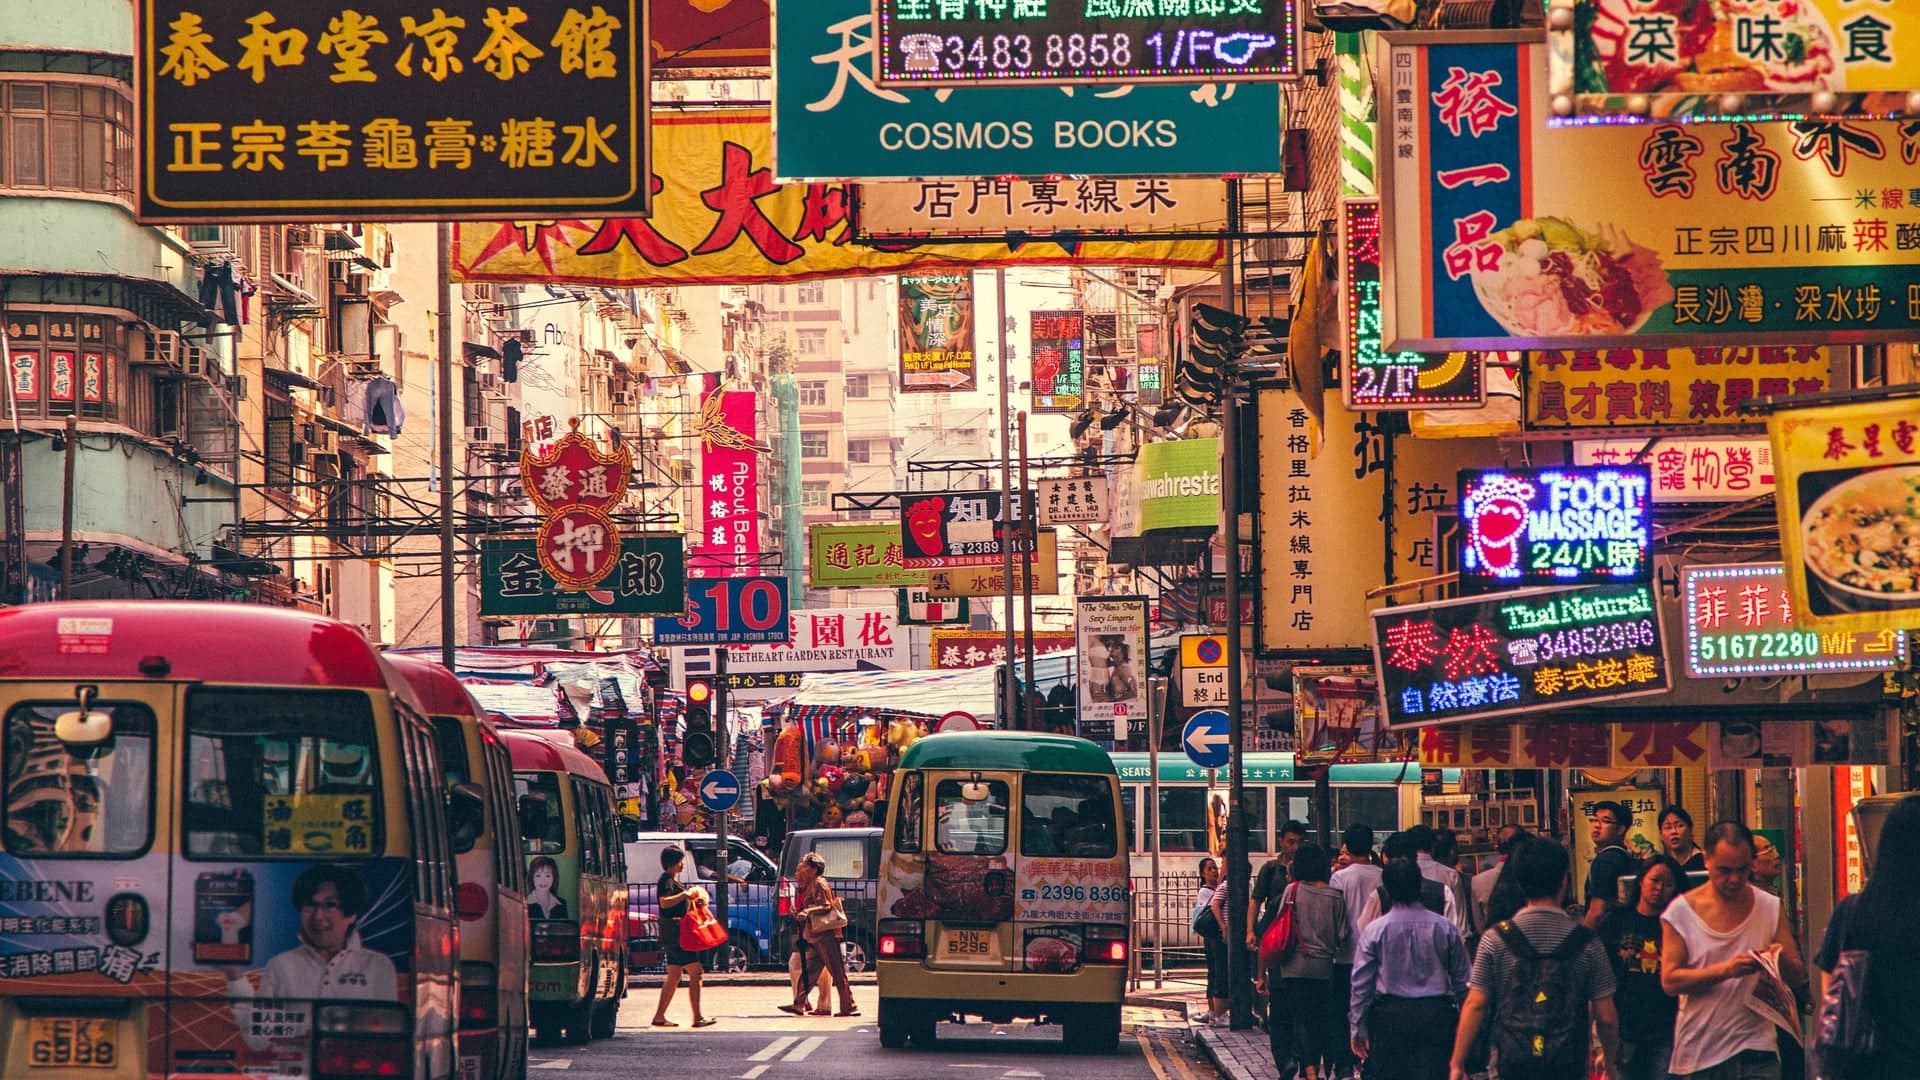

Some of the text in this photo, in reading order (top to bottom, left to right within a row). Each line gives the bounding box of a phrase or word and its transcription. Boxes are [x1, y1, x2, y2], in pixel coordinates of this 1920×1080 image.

[158, 9, 622, 87] 泰和堂涼茶館
[945, 30, 1215, 69] 3483 8858 1/F
[500, 116, 619, 169] 糖水
[879, 119, 1178, 151] COSMOS BOOKS
[1432, 66, 1516, 281] 裕一品
[1357, 365, 1418, 397] 2/F
[731, 461, 750, 515] About
[1549, 476, 1644, 512] FOOT
[1528, 510, 1642, 541] MASSAGE
[551, 517, 605, 573] 押
[967, 541, 999, 554] 2389
[1532, 542, 1640, 569] 24小時
[786, 650, 827, 662] GARDEN
[829, 647, 894, 660] RESTAURANT
[1538, 619, 1654, 660] 34852996
[1198, 672, 1223, 683] End
[1122, 767, 1151, 778] SEATS
[1041, 886, 1085, 901] 2396
